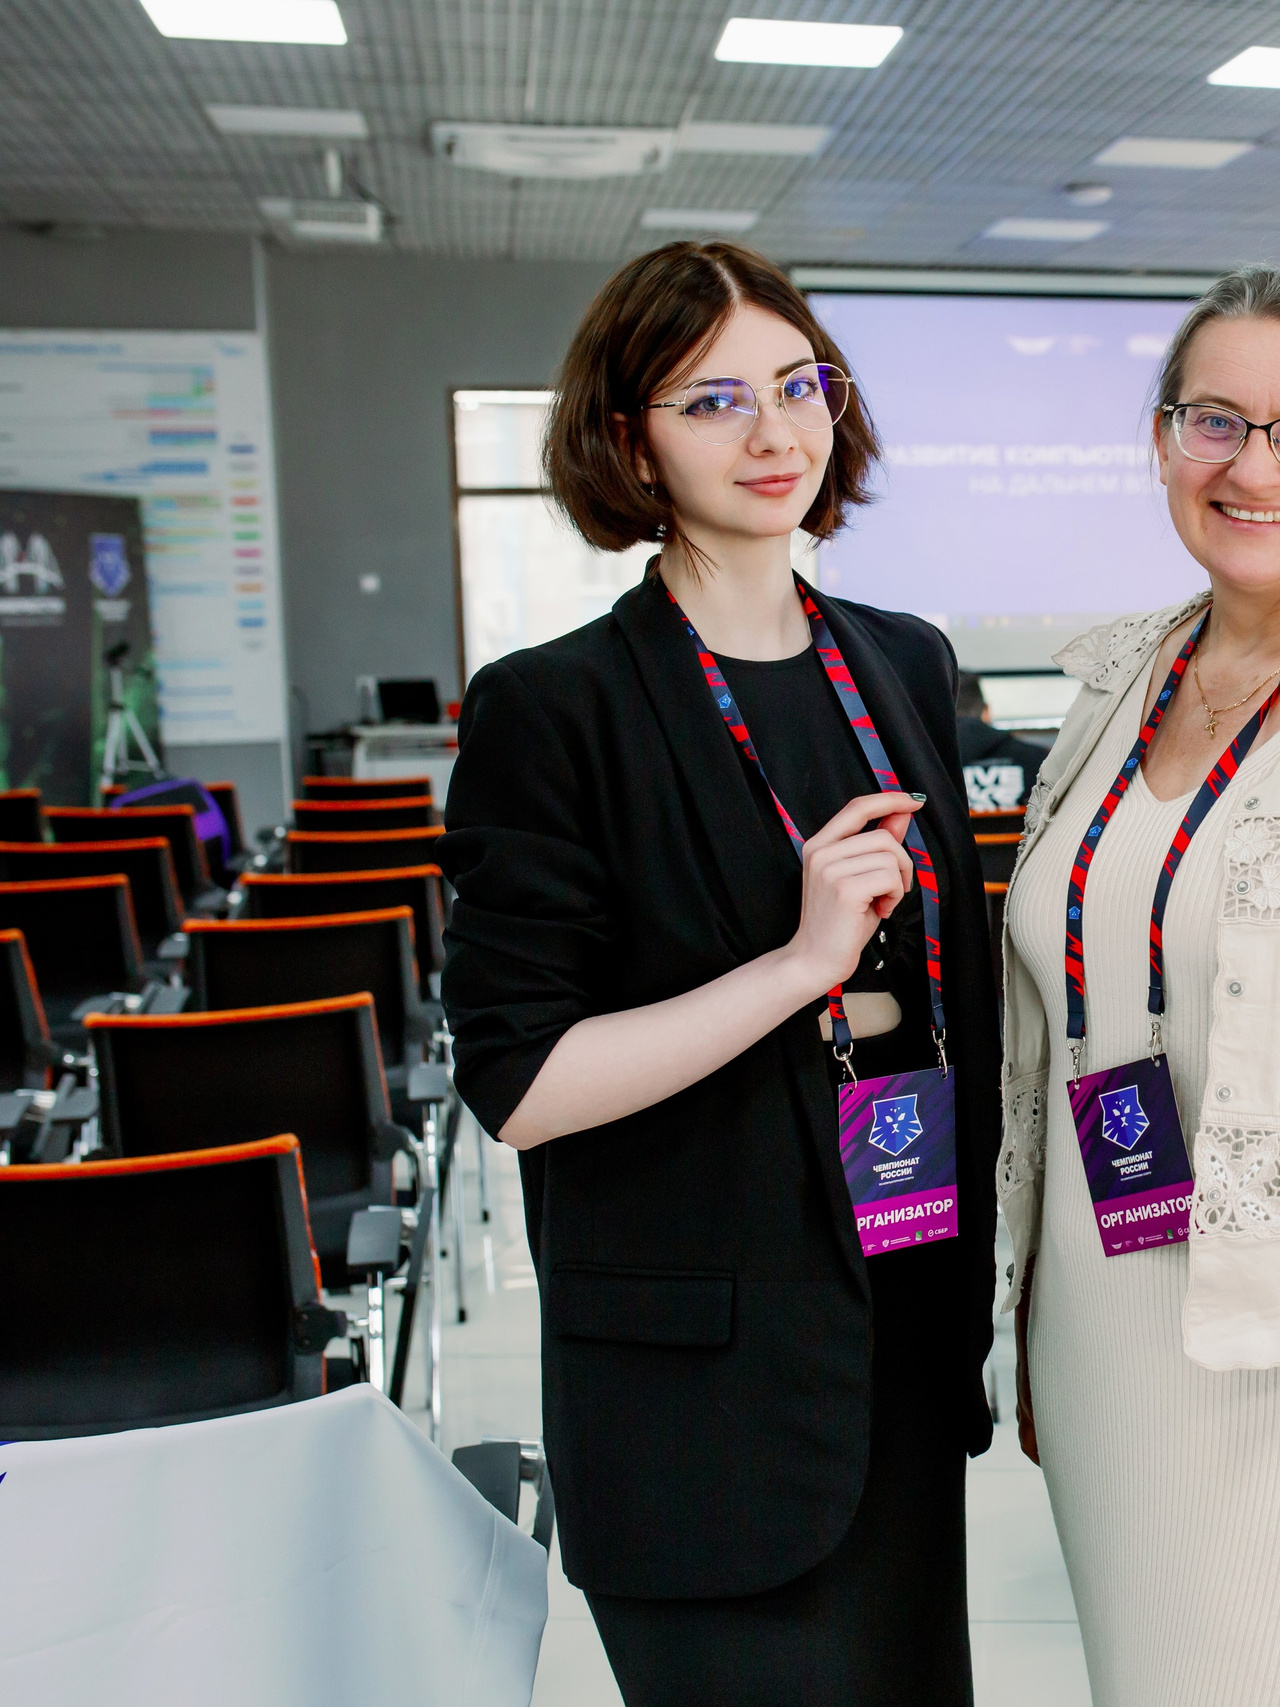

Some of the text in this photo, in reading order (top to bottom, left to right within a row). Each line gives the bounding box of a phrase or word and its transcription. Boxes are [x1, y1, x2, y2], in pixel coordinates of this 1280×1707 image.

[873, 1157, 920, 1173] ЧЕМПИОНАТ
[1111, 1151, 1153, 1168] ЧЕМПИОНАТ
[881, 1167, 913, 1181] РОССИИ
[1120, 1162, 1149, 1176] РОССИИ
[857, 1198, 954, 1231] РГАНИЗАТОР
[934, 1227, 949, 1236] СБЕР
